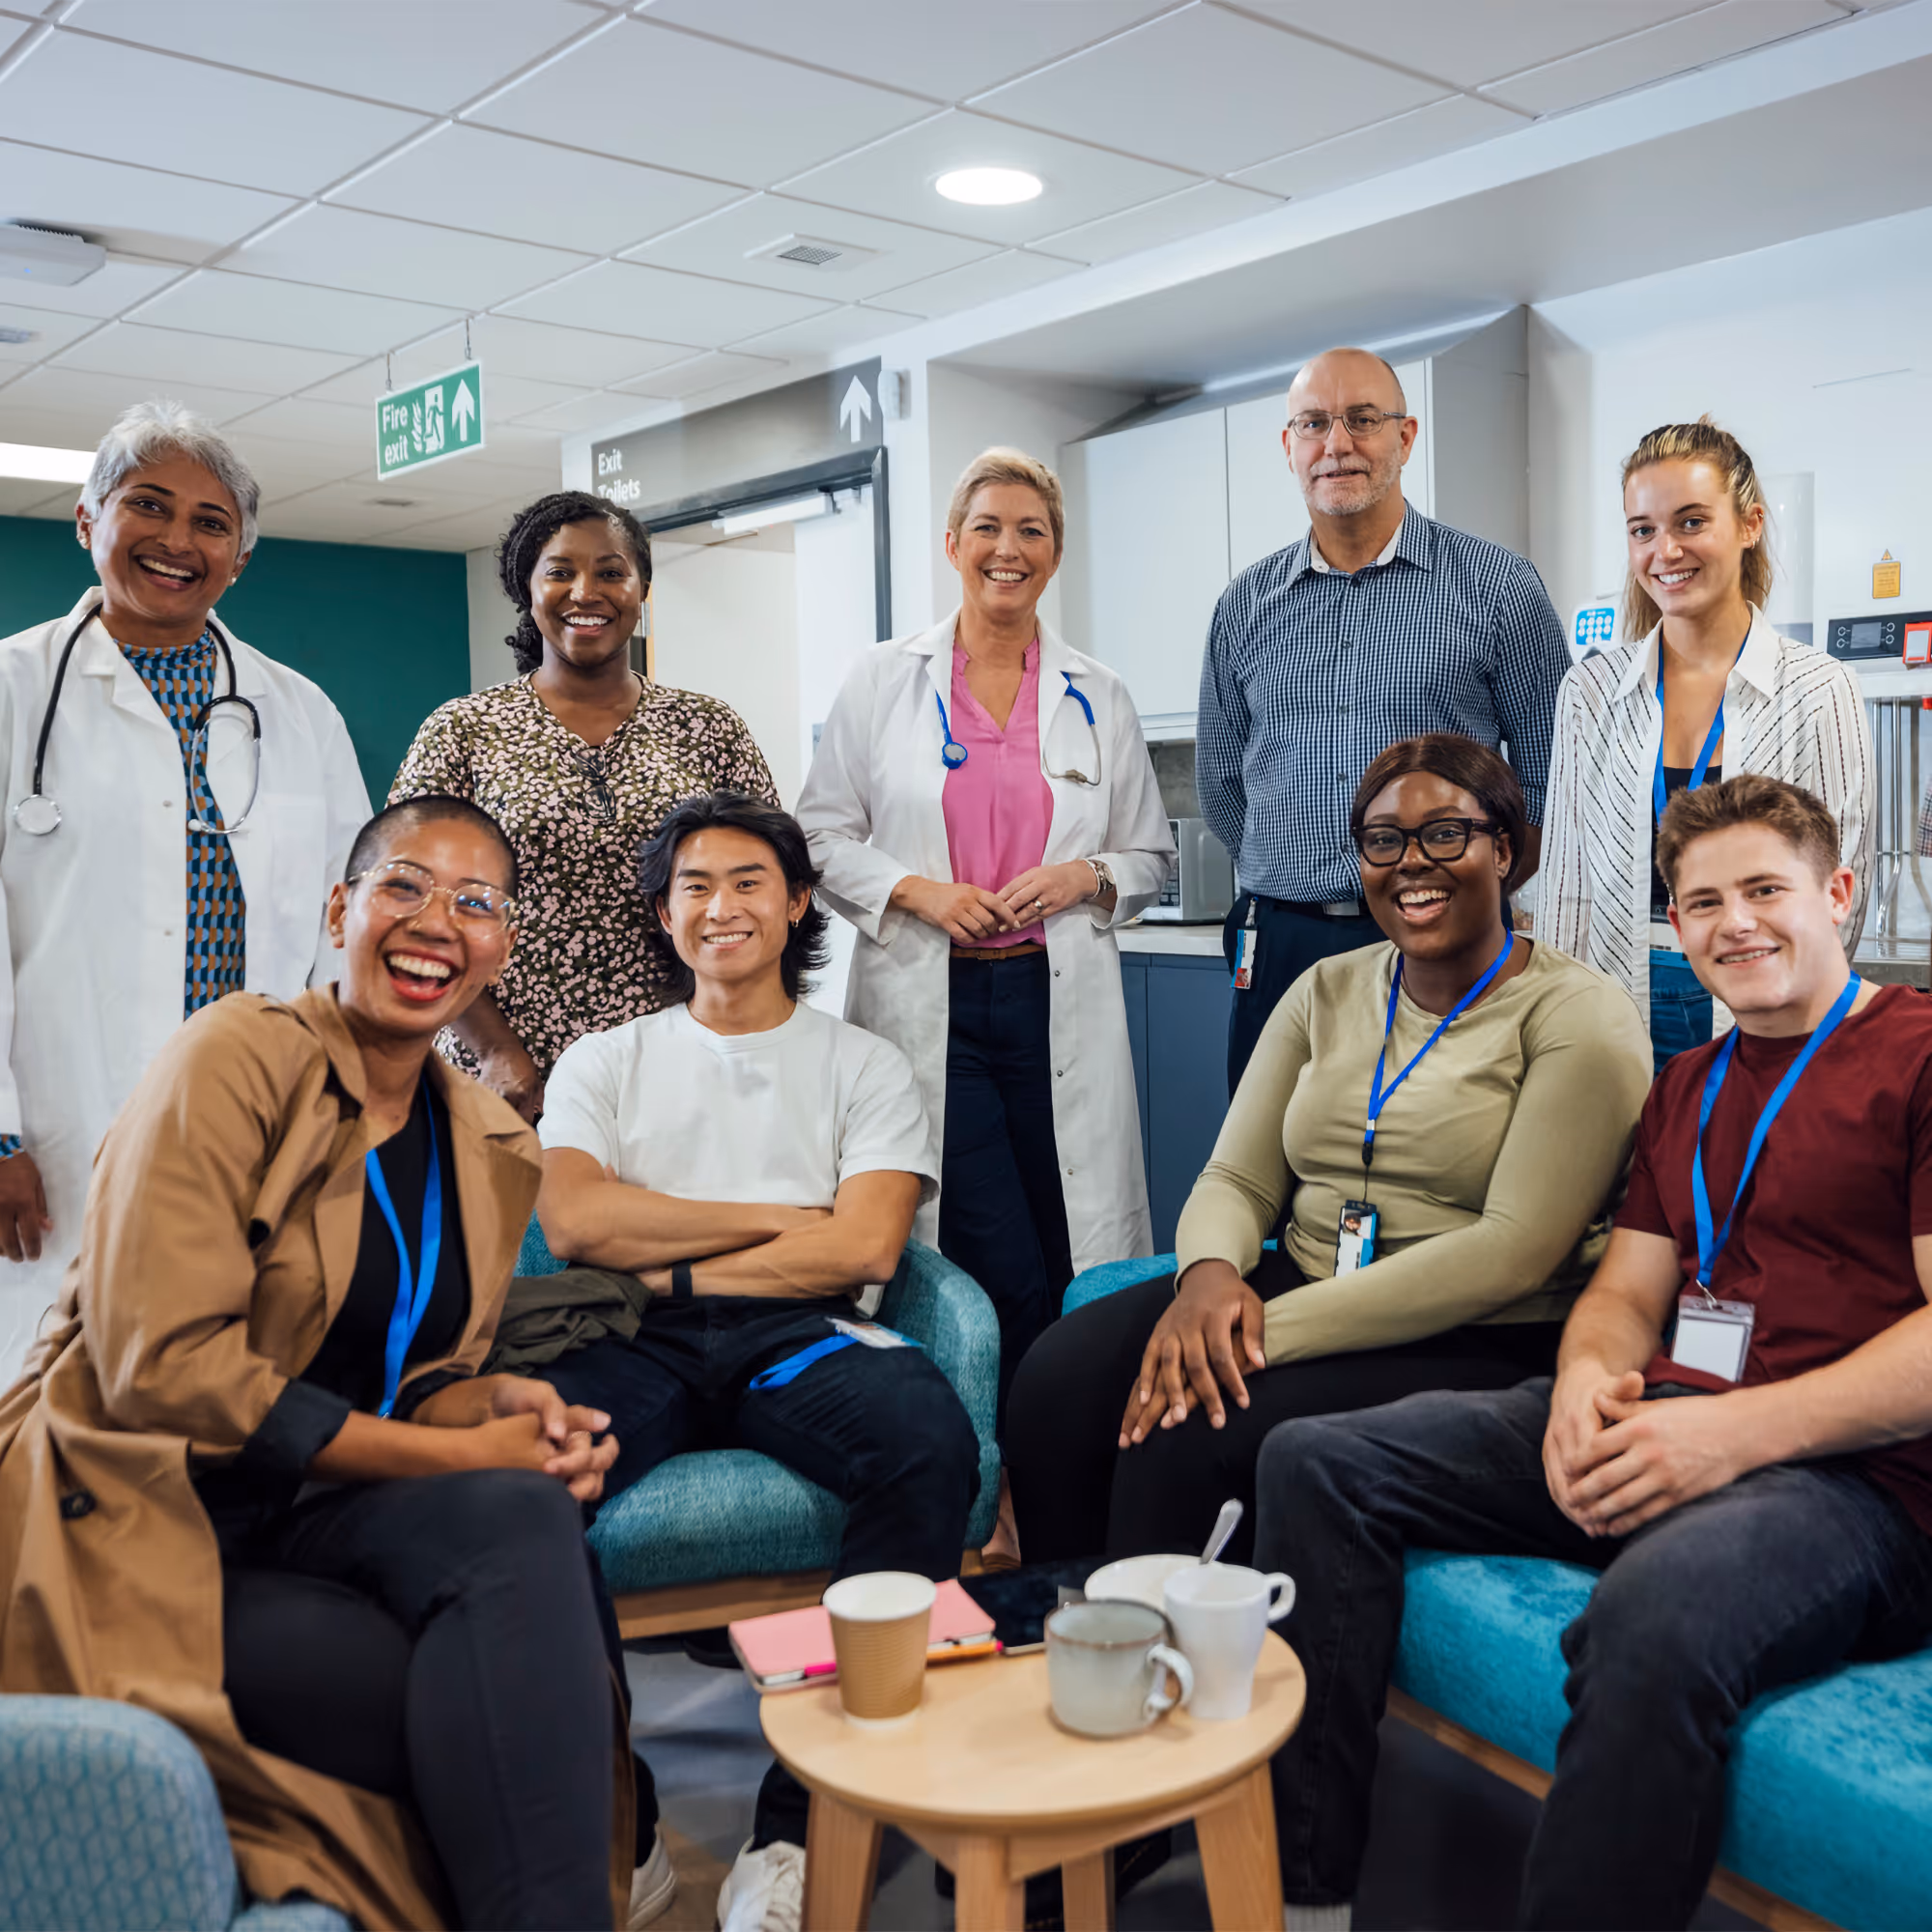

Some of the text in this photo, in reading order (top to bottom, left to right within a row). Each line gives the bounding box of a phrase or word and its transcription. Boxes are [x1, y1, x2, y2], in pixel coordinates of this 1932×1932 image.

[383, 403, 409, 434] Fire
[384, 434, 409, 466] exit
[598, 448, 623, 476] Exit
[597, 478, 640, 505] Toilets
